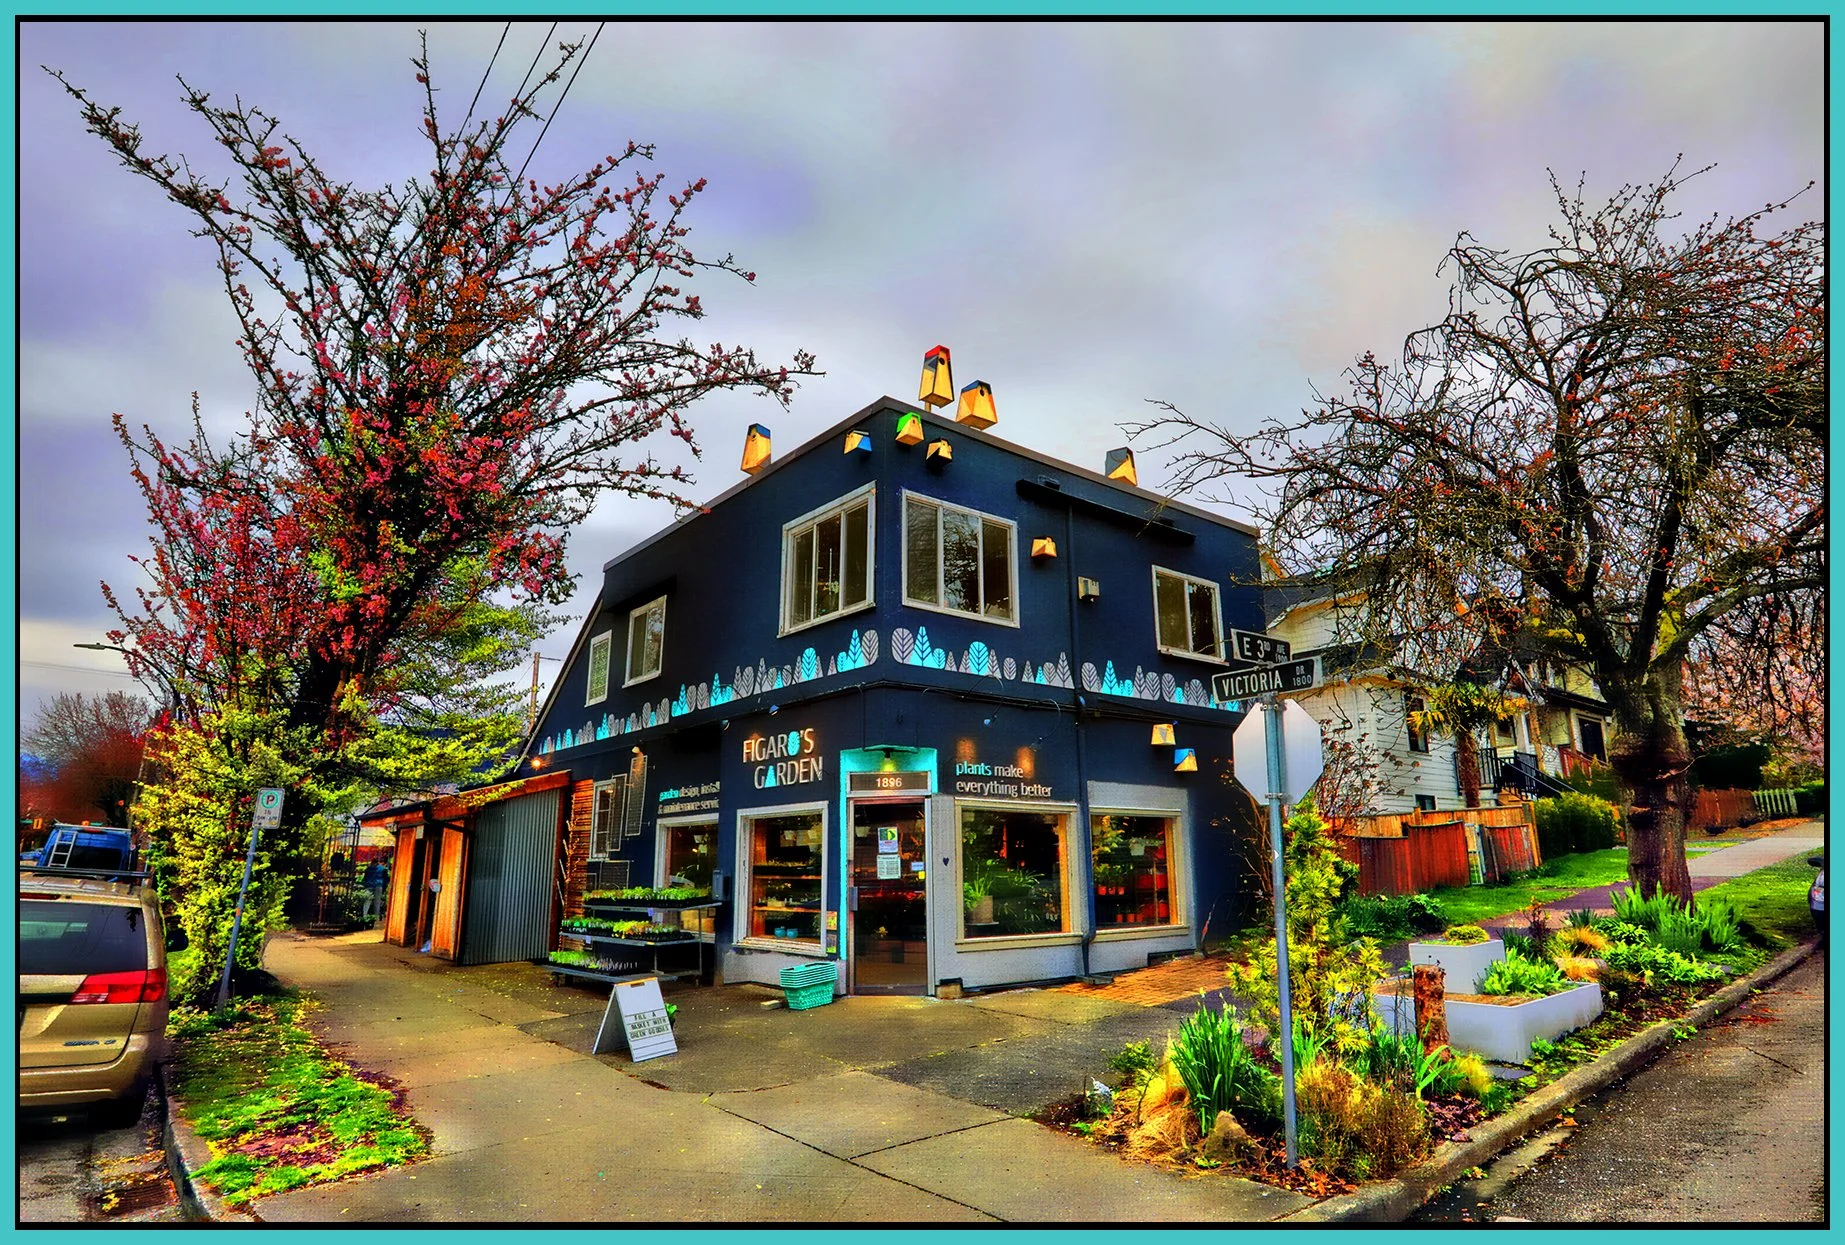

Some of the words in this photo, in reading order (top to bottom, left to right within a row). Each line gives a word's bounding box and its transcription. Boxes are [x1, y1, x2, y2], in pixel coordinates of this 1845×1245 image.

[1243, 637, 1252, 656] E
[1295, 665, 1305, 675] DR
[1222, 670, 1283, 697] VICTORIA
[1292, 675, 1312, 687] 1800
[743, 728, 815, 763] FIGARO'S
[754, 756, 823, 789] GARDEN
[956, 761, 992, 776] plants
[994, 765, 1023, 778] make
[876, 777, 902, 788] 1896
[956, 780, 1018, 798] everything
[1020, 782, 1052, 797] better
